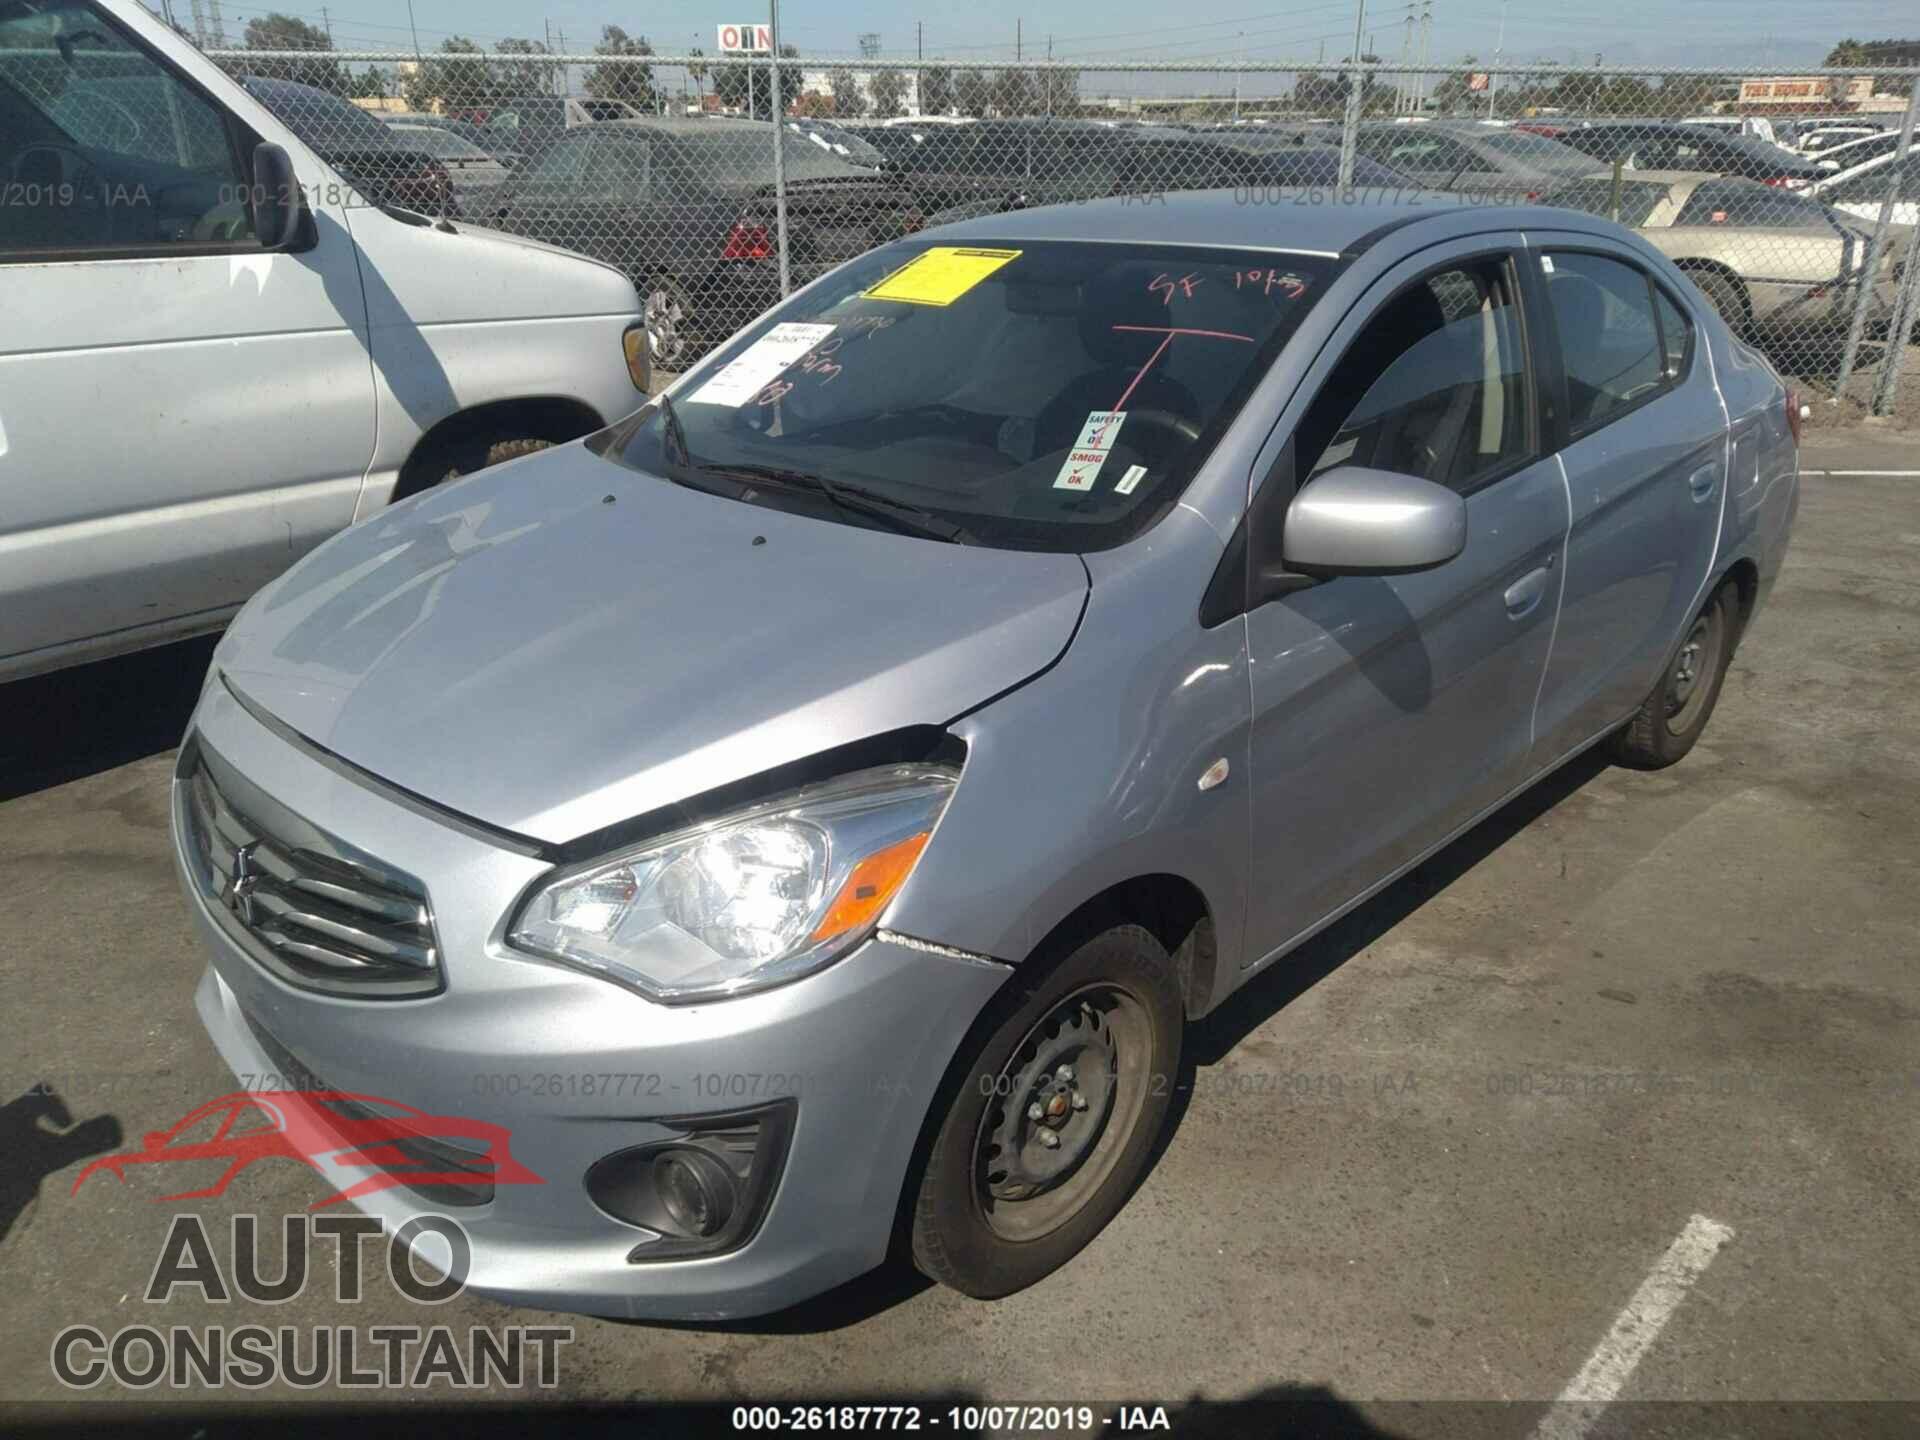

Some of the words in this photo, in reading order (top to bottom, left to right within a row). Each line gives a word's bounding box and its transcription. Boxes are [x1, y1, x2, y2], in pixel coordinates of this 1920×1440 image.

[1088, 415, 1122, 424] SAFETY
[1070, 453, 1105, 463] SMOG
[1067, 475, 1084, 484] OK
